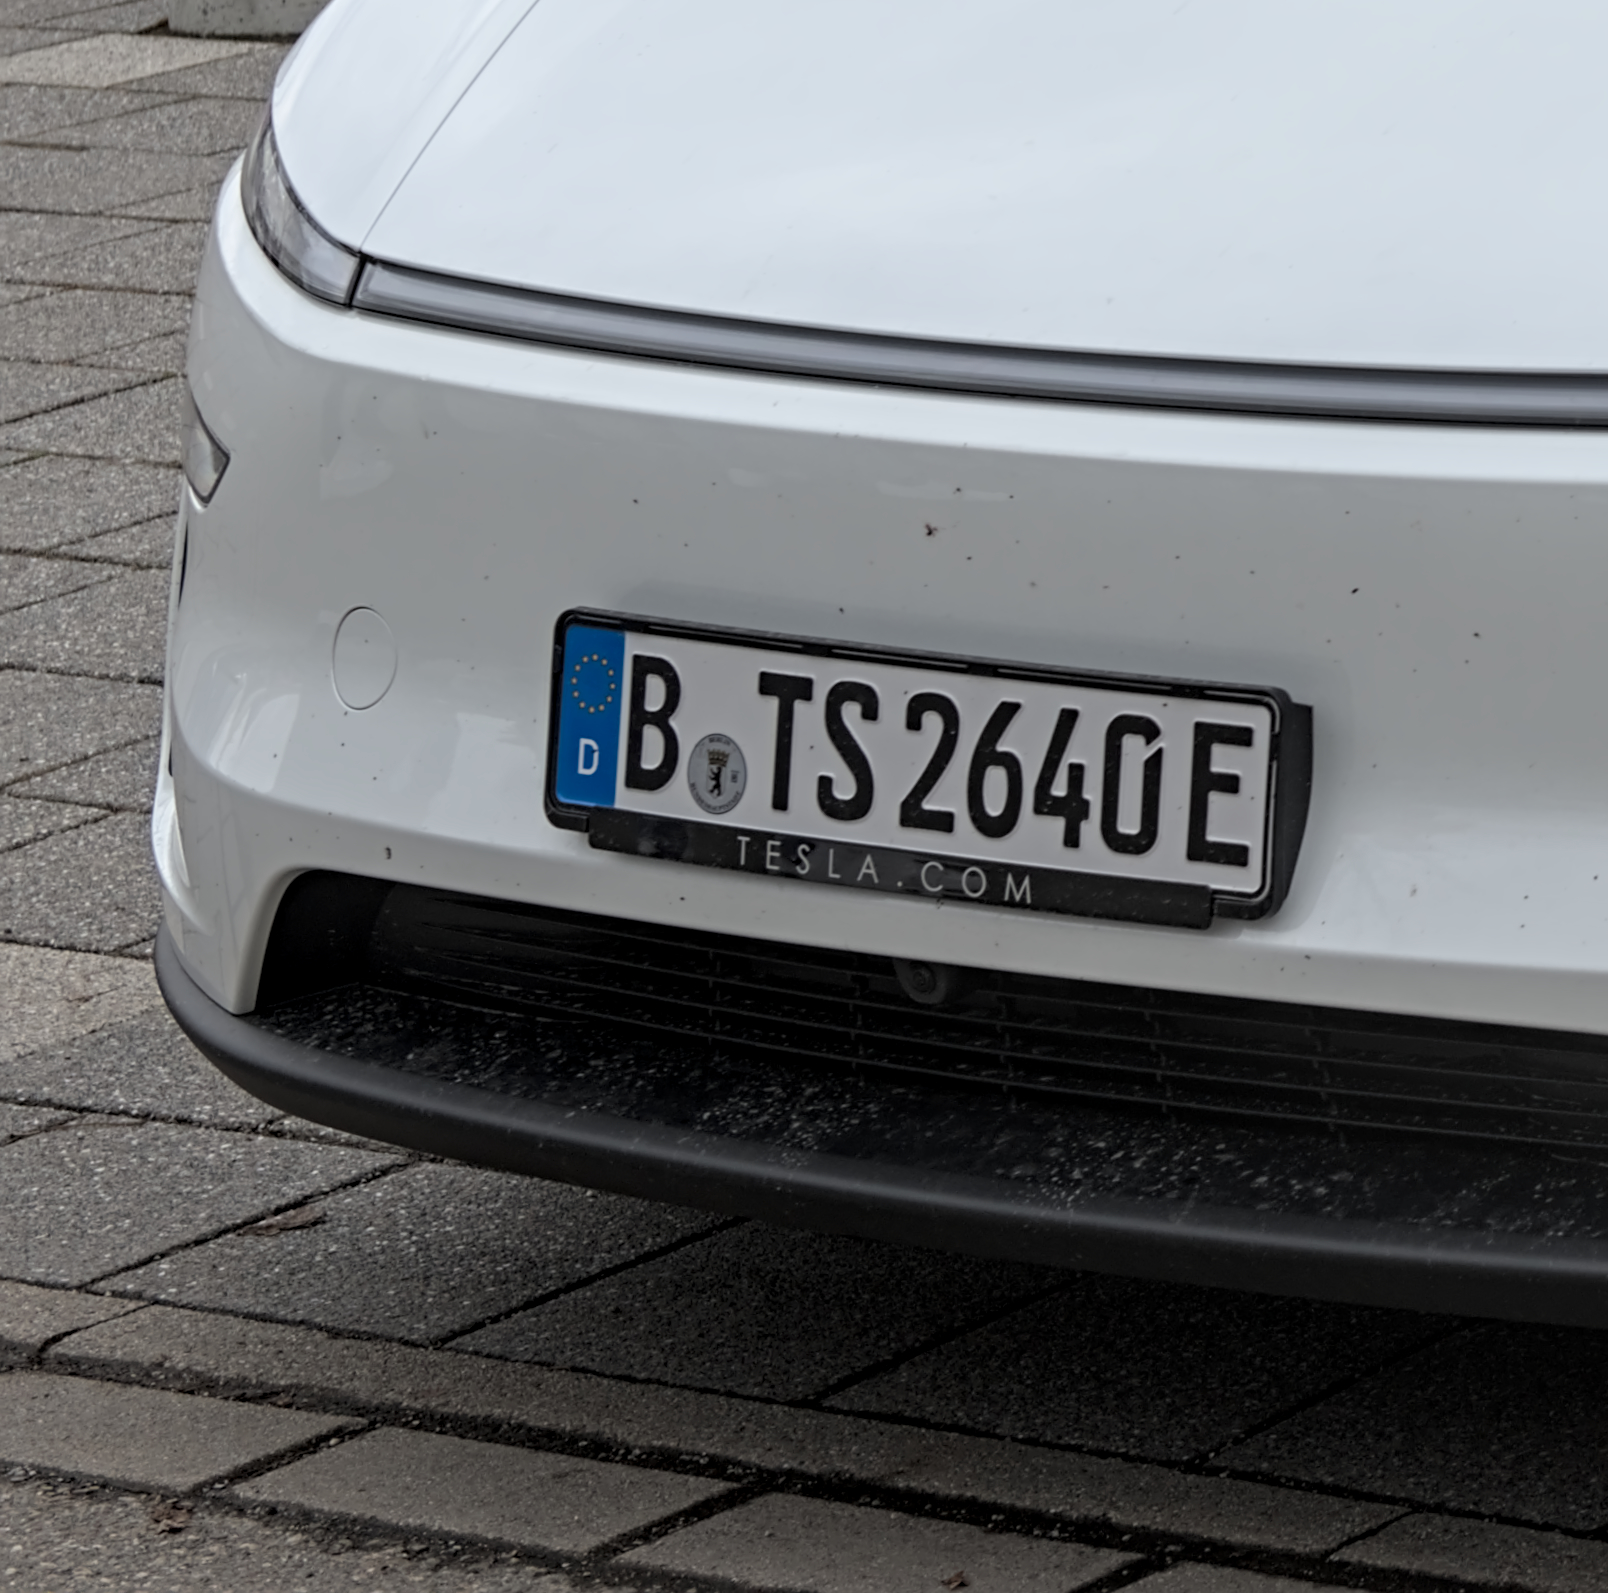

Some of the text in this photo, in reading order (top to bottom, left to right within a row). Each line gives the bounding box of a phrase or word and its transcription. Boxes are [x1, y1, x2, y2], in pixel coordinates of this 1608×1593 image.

[576, 737, 600, 777] D
[624, 654, 682, 793] B
[736, 835, 1036, 907] TESLA.COM
